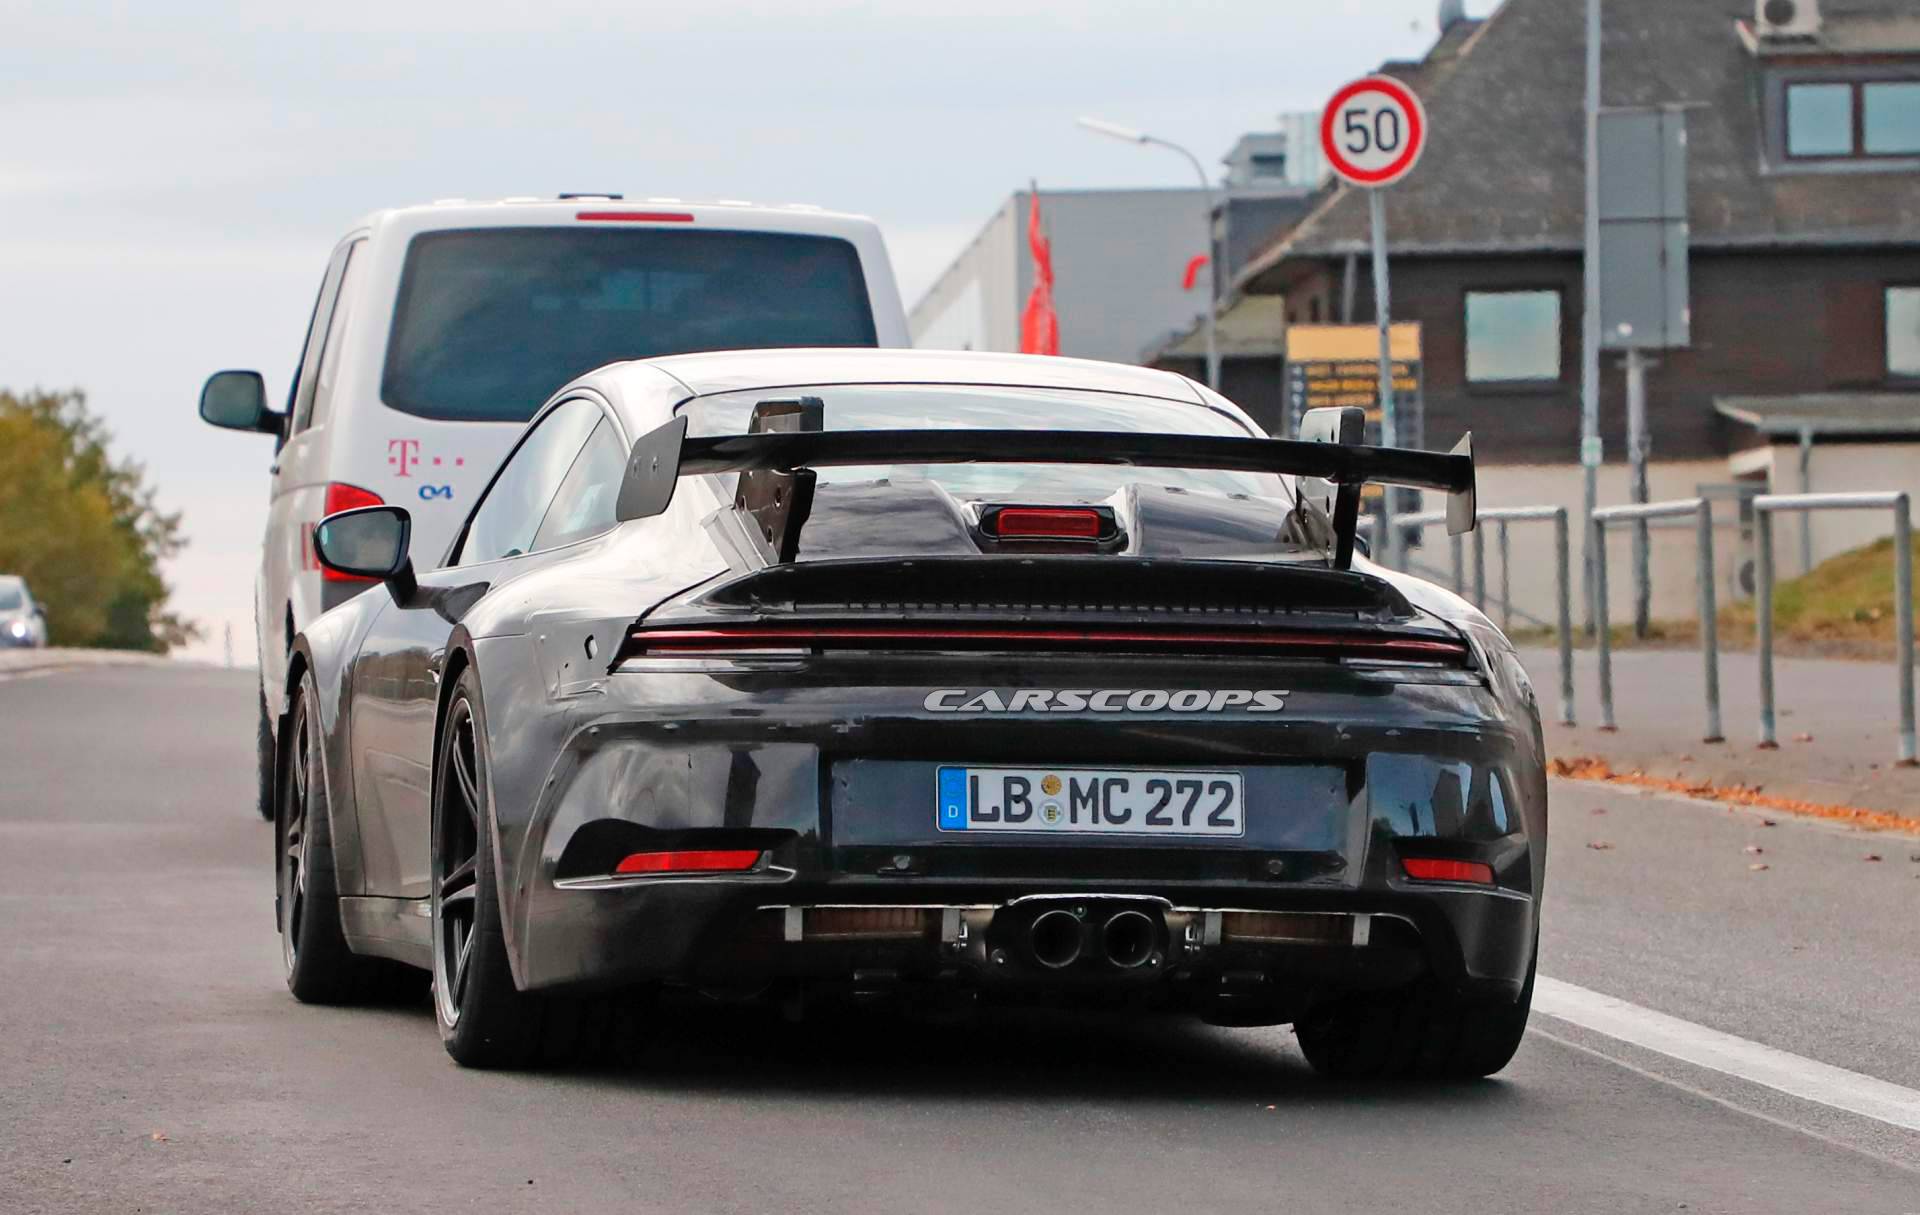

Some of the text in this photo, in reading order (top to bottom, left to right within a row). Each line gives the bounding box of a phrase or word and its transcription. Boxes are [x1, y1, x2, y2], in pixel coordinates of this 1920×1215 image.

[1345, 107, 1399, 153] 50
[948, 804, 959, 818] D
[969, 775, 1235, 827] LB MC 272
